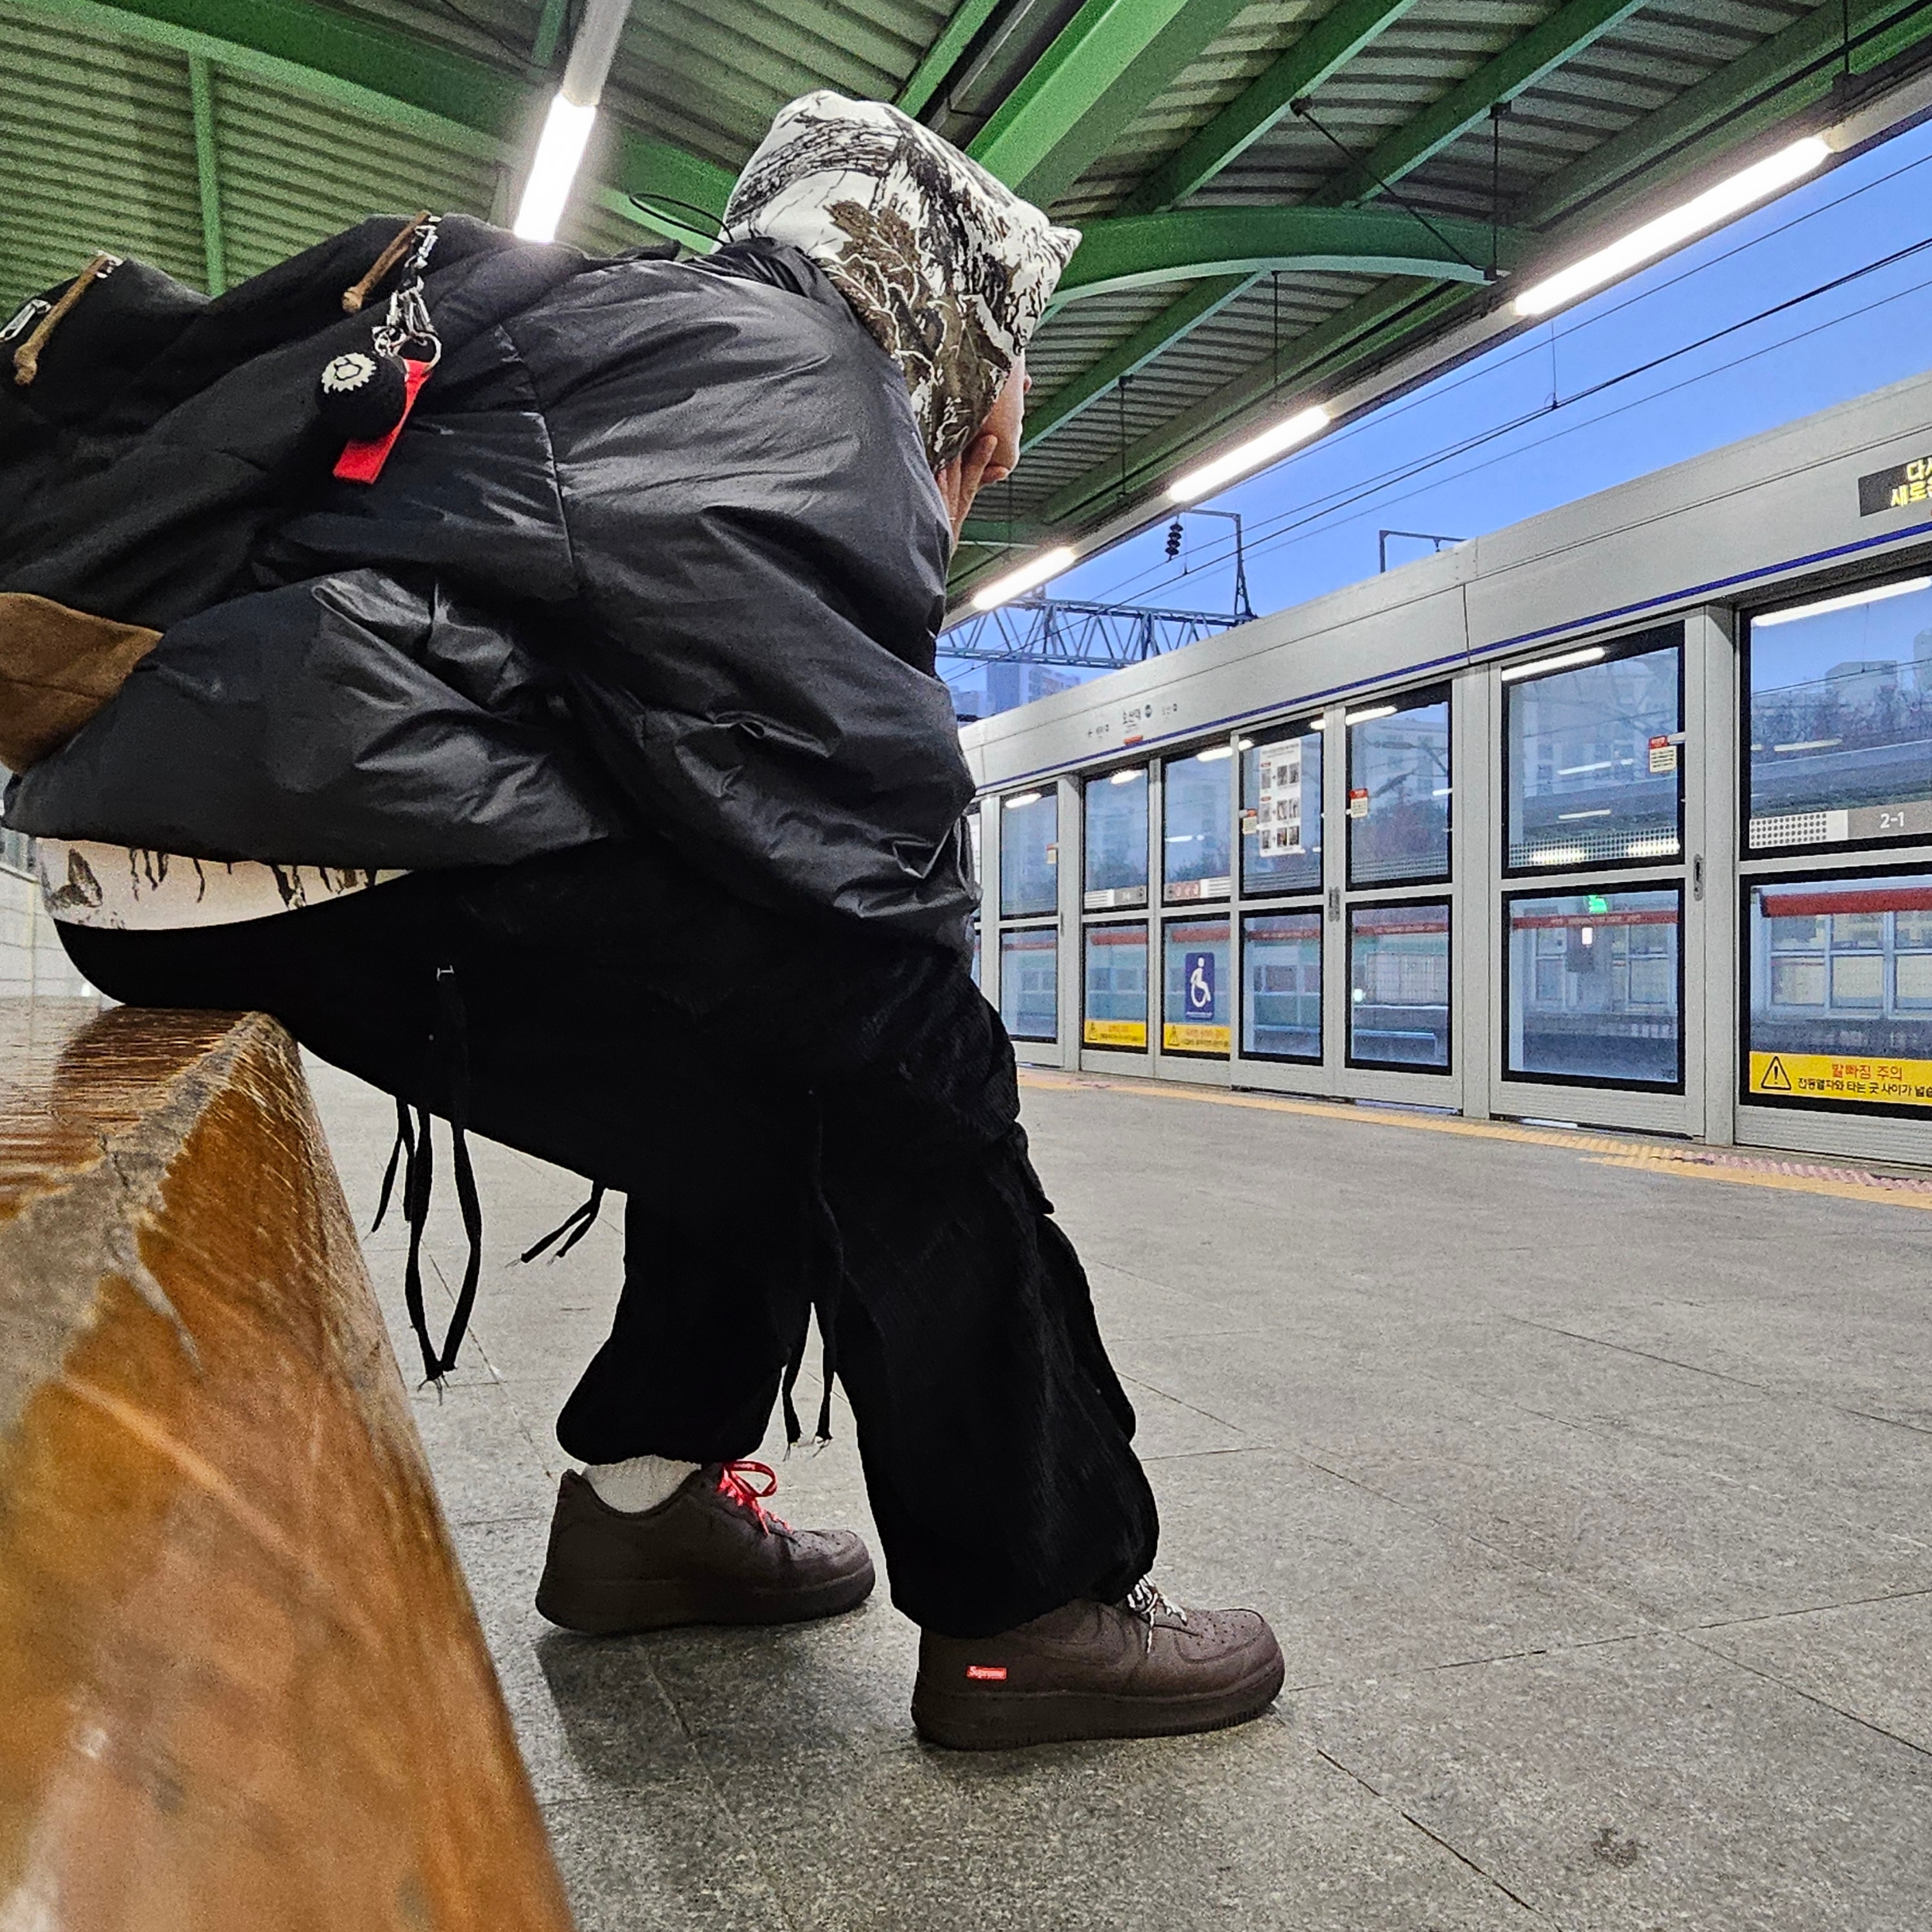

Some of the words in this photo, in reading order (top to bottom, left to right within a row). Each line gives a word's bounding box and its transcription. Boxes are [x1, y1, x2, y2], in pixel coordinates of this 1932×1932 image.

[1880, 812, 1905, 829] 2-1
[1831, 1063, 1872, 1079] 발빠짐
[1877, 1066, 1903, 1081] 주의
